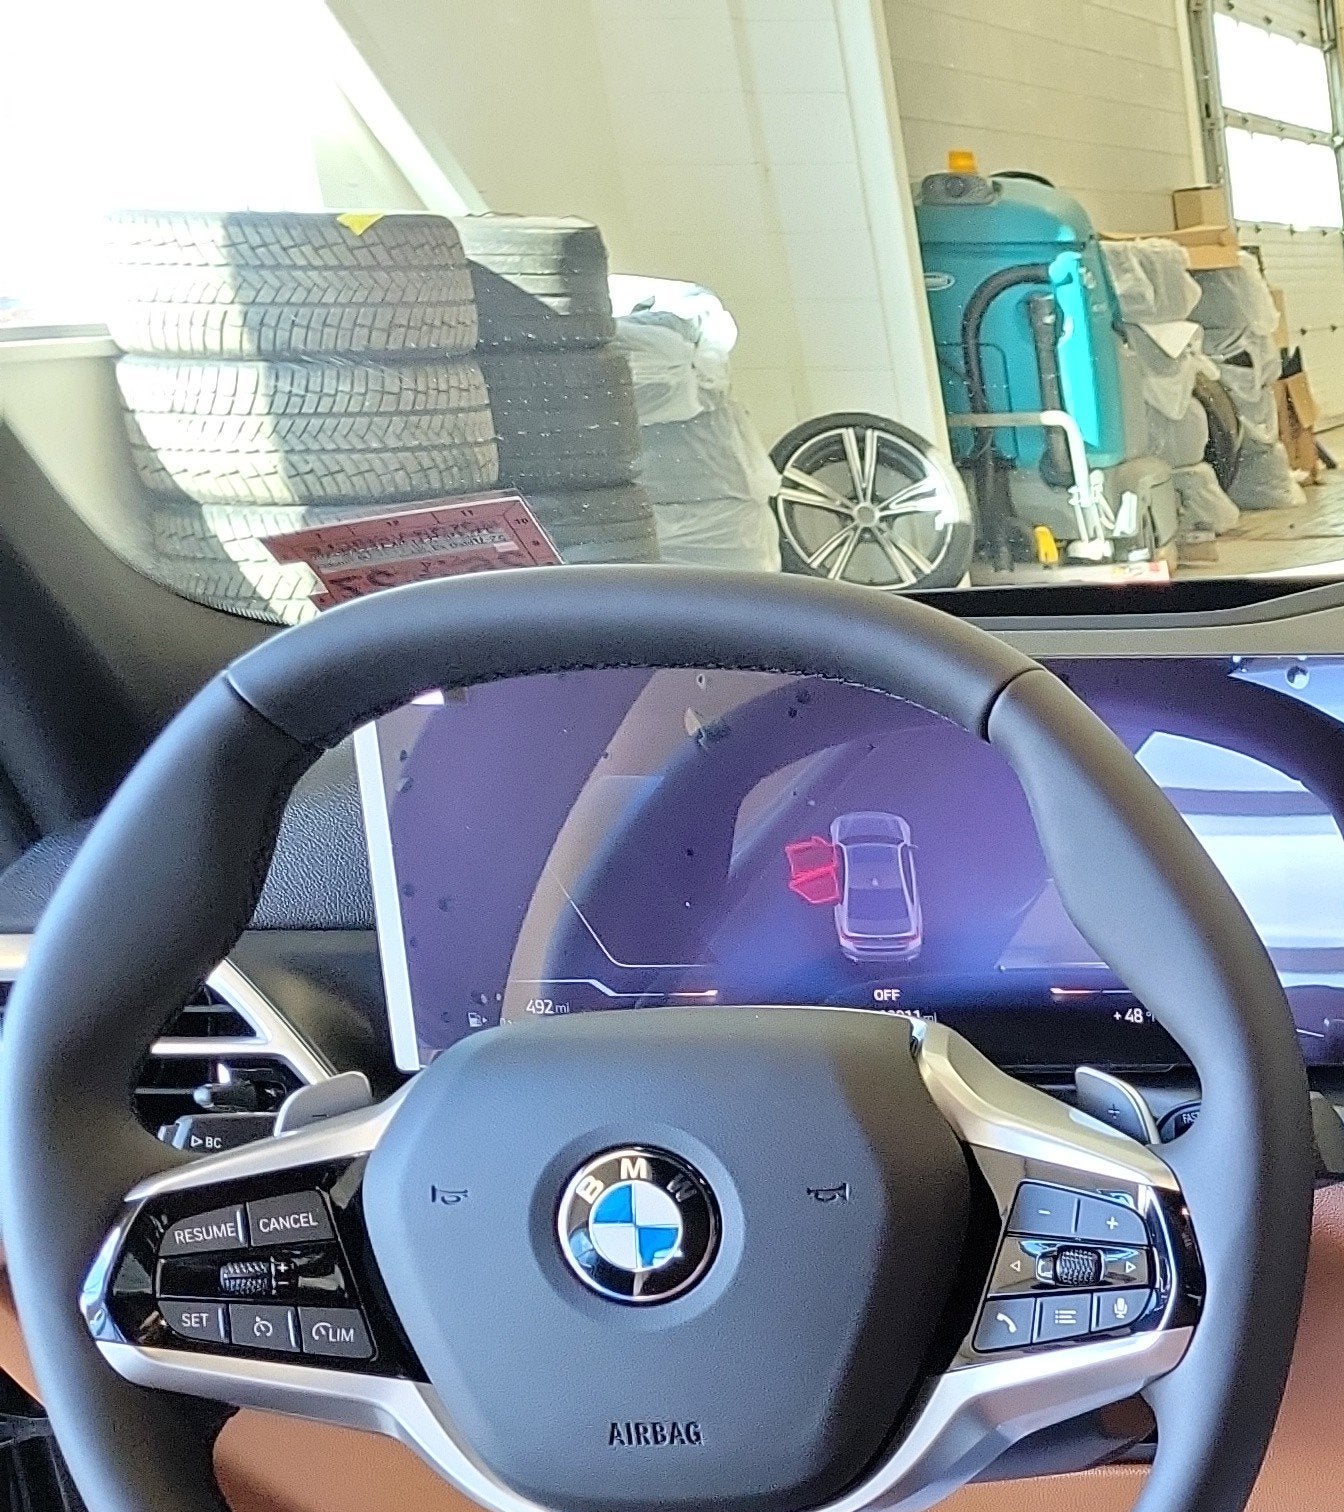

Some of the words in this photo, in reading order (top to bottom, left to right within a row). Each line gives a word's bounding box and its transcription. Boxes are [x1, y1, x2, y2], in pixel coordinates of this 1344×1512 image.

[873, 989, 901, 1001] OFF
[526, 1000, 554, 1014] 492
[555, 1002, 570, 1013] mi
[206, 1138, 222, 1148] BC
[575, 1157, 698, 1205] BMW
[259, 1212, 318, 1233] CANCEL
[174, 1223, 236, 1244] RESUME
[181, 1313, 209, 1327] SET
[329, 1328, 354, 1342] LIM
[609, 1421, 702, 1446] AIRBAG
